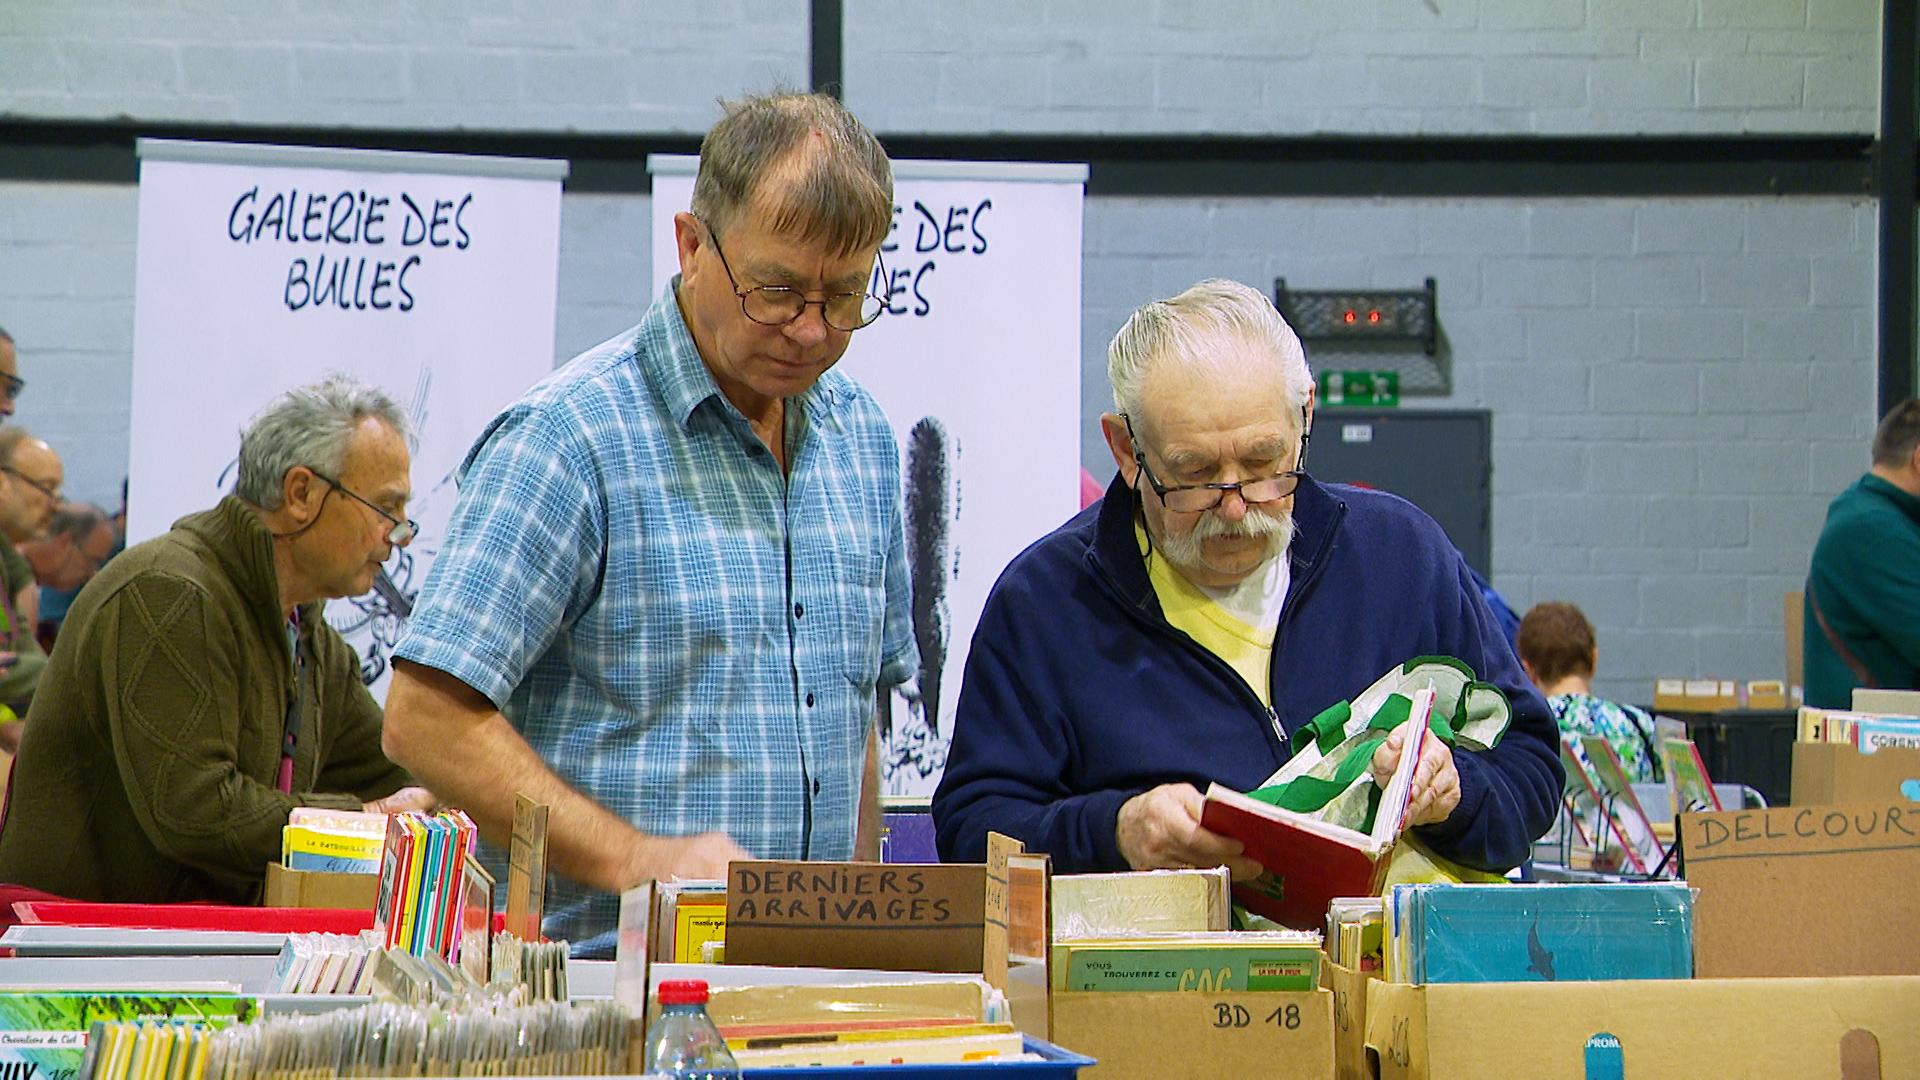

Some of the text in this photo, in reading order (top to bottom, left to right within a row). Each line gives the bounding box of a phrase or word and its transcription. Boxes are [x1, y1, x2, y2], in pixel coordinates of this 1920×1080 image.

[401, 192, 473, 250] DES
[914, 198, 993, 255] DES
[284, 254, 421, 312] BULLES
[735, 867, 925, 895] DERNIERS
[736, 897, 952, 923] ARRIVAGES
[1086, 961, 1112, 970] VOUS
[1213, 1002, 1301, 1030] BD 18
